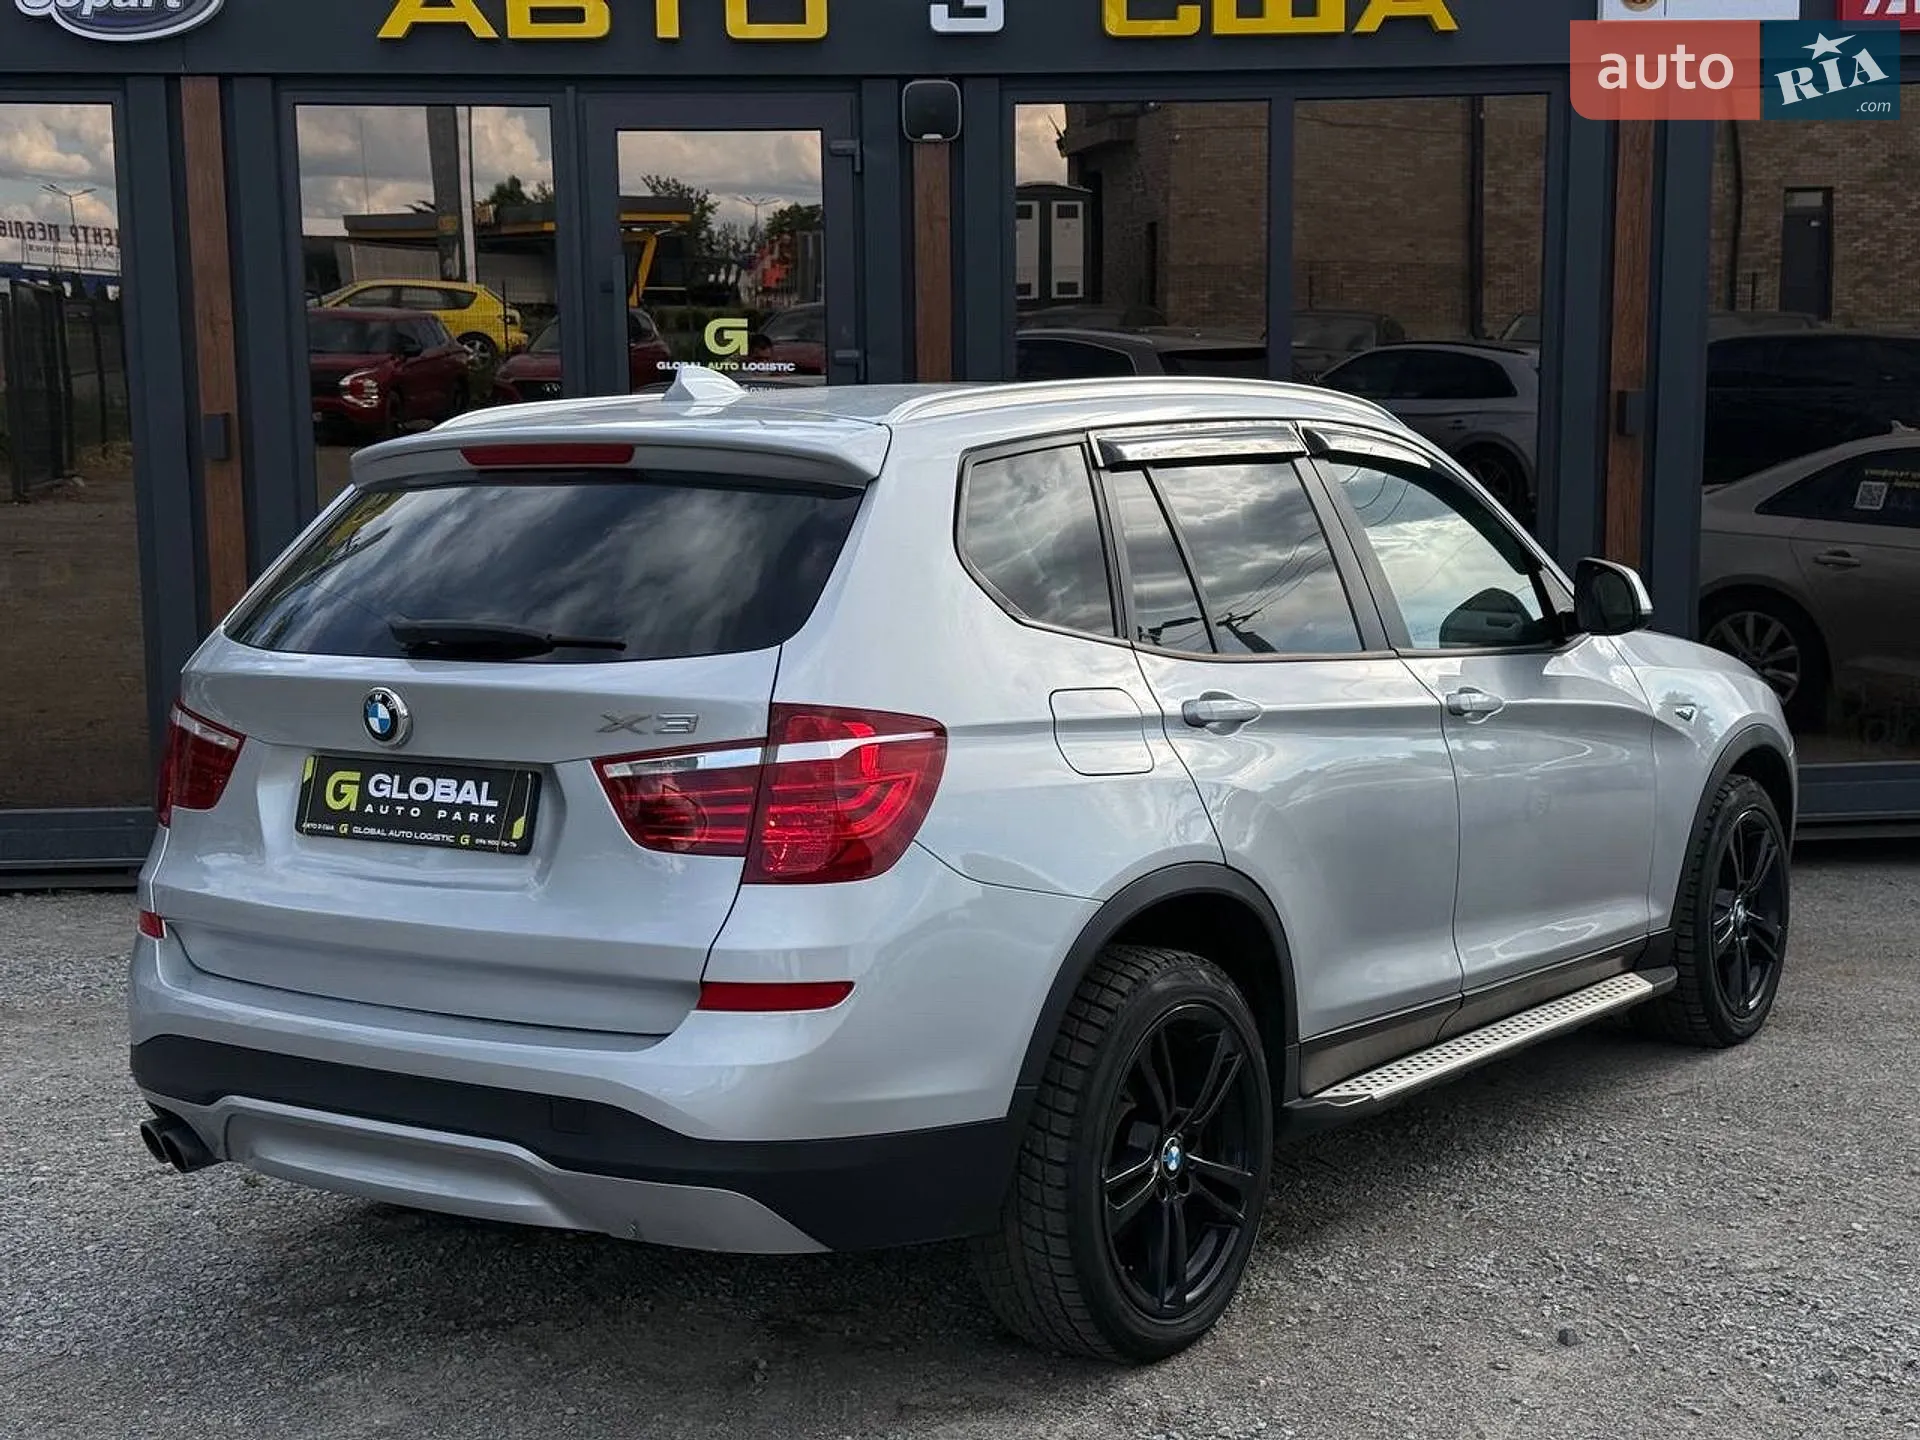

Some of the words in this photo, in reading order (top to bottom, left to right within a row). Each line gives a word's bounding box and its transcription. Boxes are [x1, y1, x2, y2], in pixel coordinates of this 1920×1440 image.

[708, 362, 739, 371] AUTO
[742, 362, 796, 372] LOGISTIC
[595, 713, 699, 735] X3
[368, 773, 499, 807] GLOBAL
[364, 803, 421, 818] AUTO
[437, 810, 496, 824] PARK
[352, 826, 387, 837] GLOBAL
[388, 829, 414, 839] AUTO
[414, 832, 456, 843] LOGISTIC
